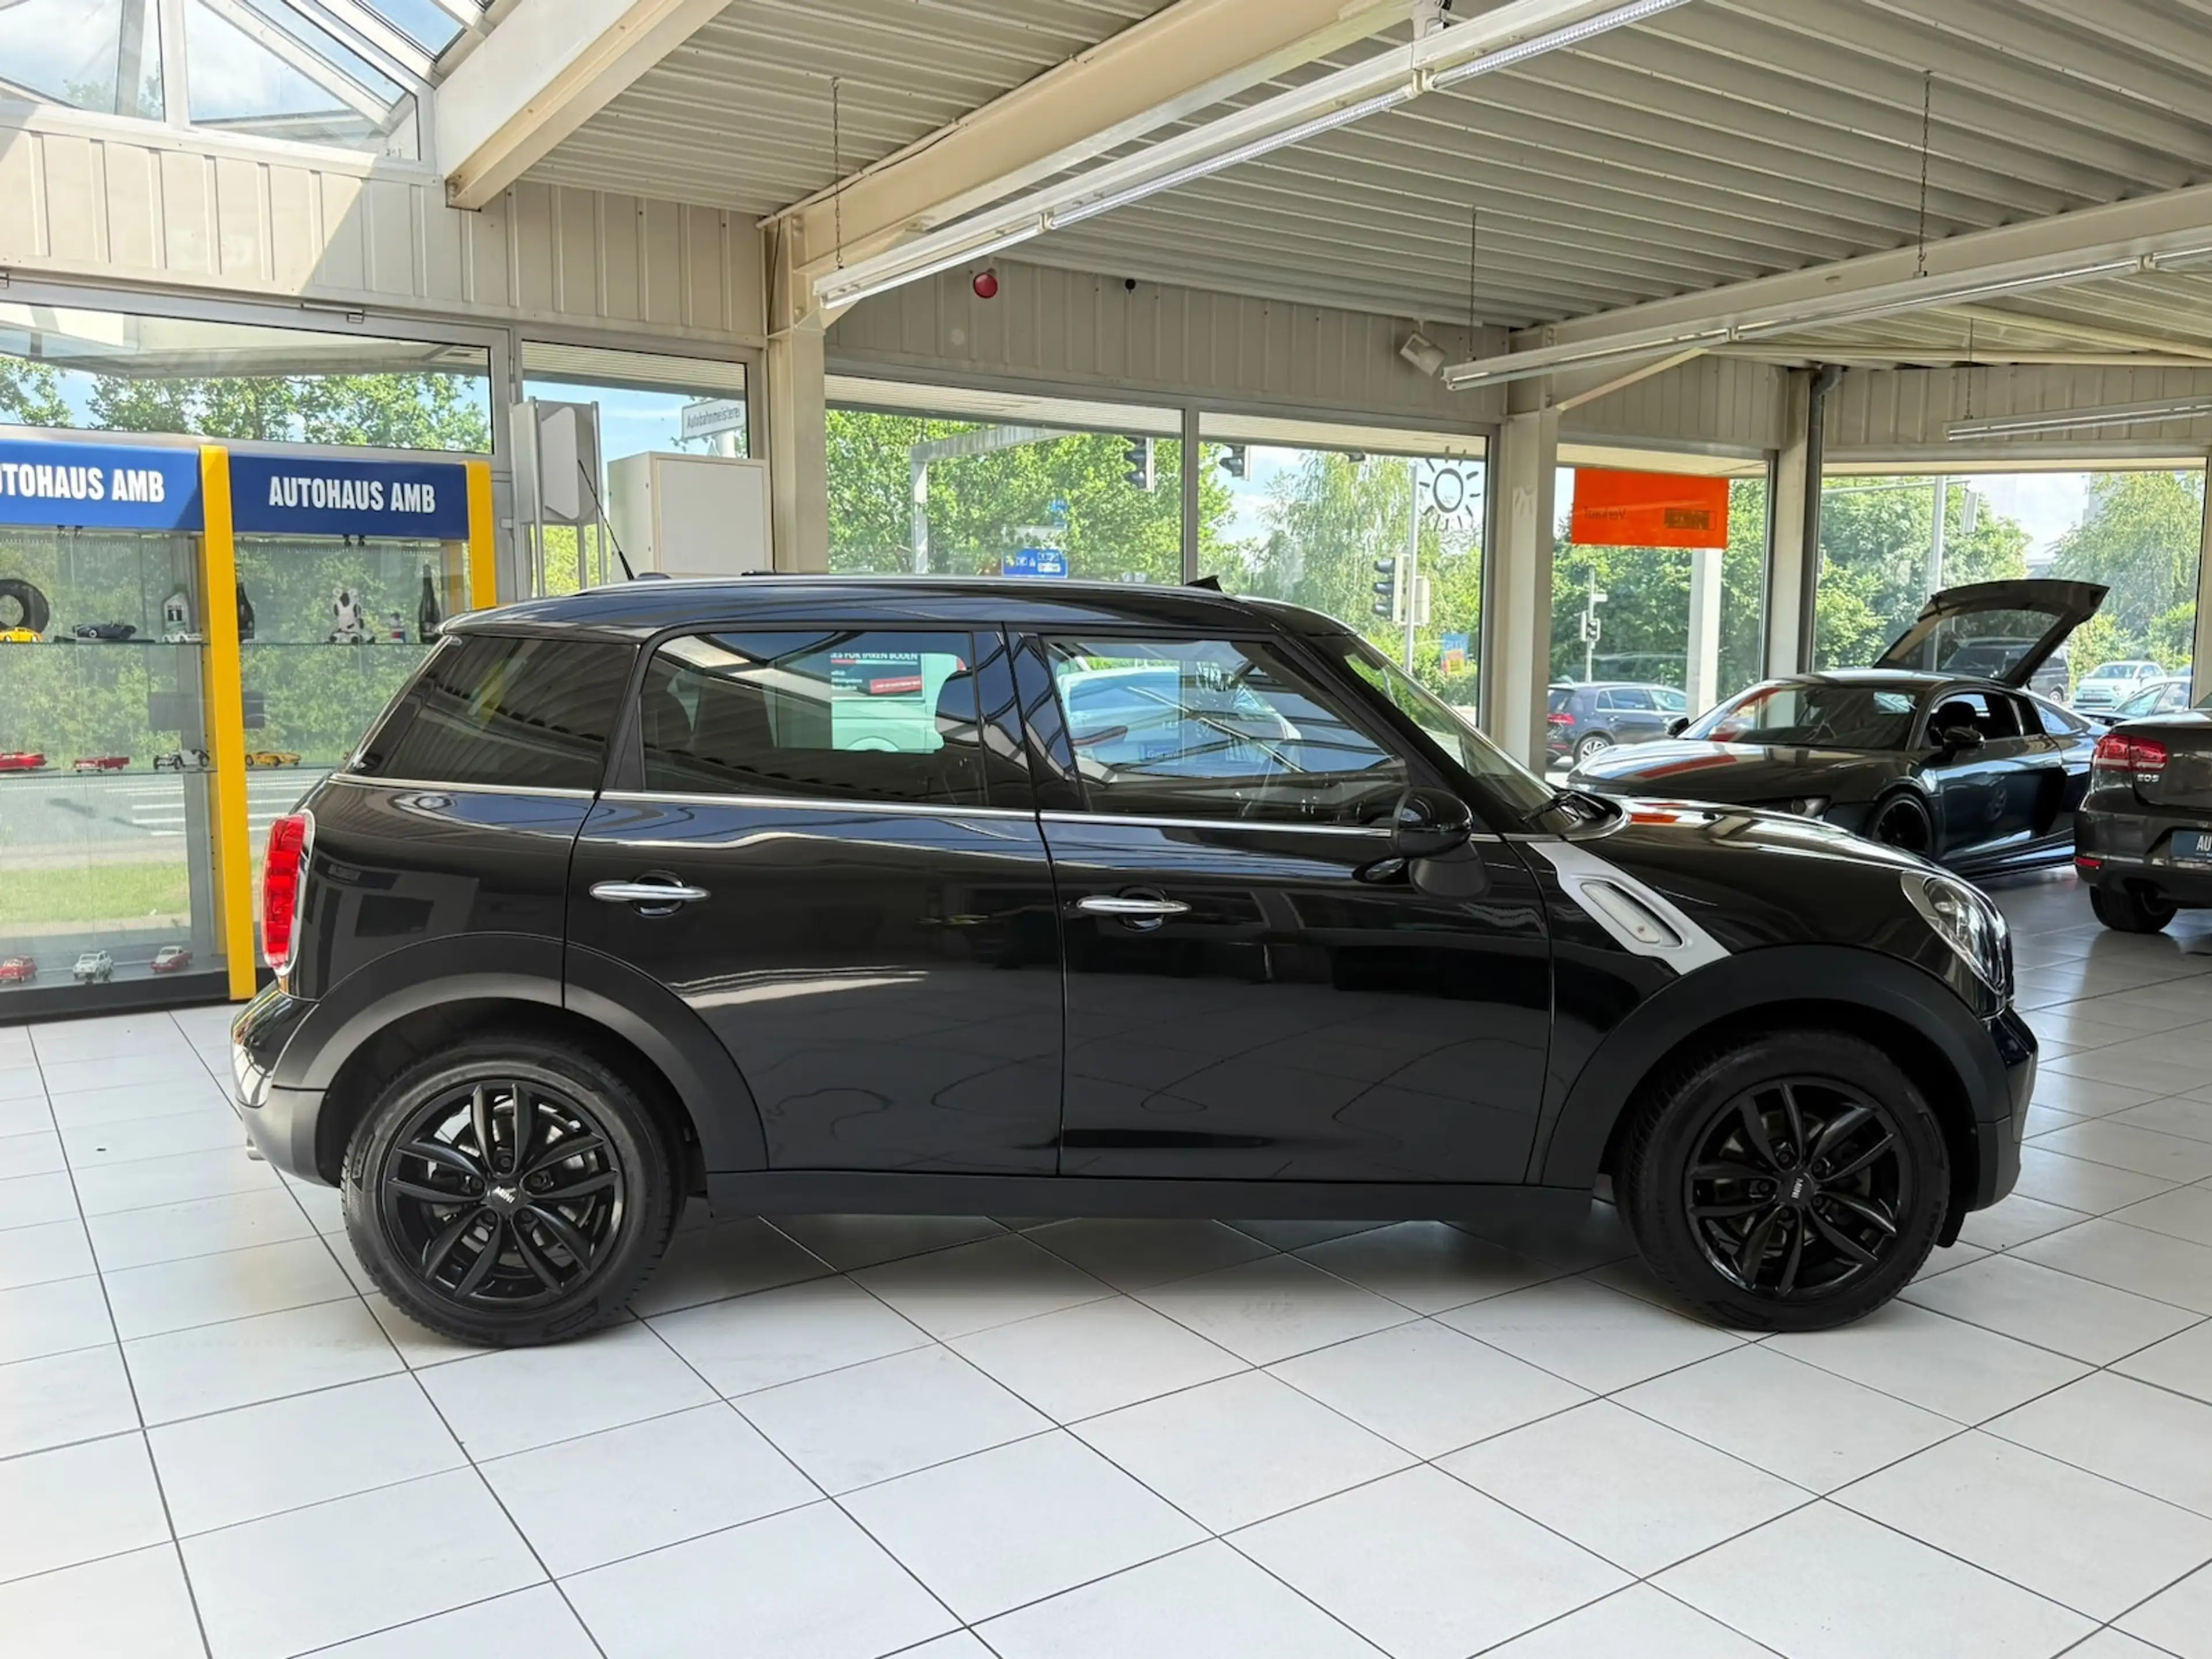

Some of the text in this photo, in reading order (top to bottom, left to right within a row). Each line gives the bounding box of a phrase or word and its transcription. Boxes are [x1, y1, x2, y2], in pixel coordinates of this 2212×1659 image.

[0, 463, 165, 503] TOHAUS AMB
[268, 476, 435, 513] AUTOHAUS AMB
